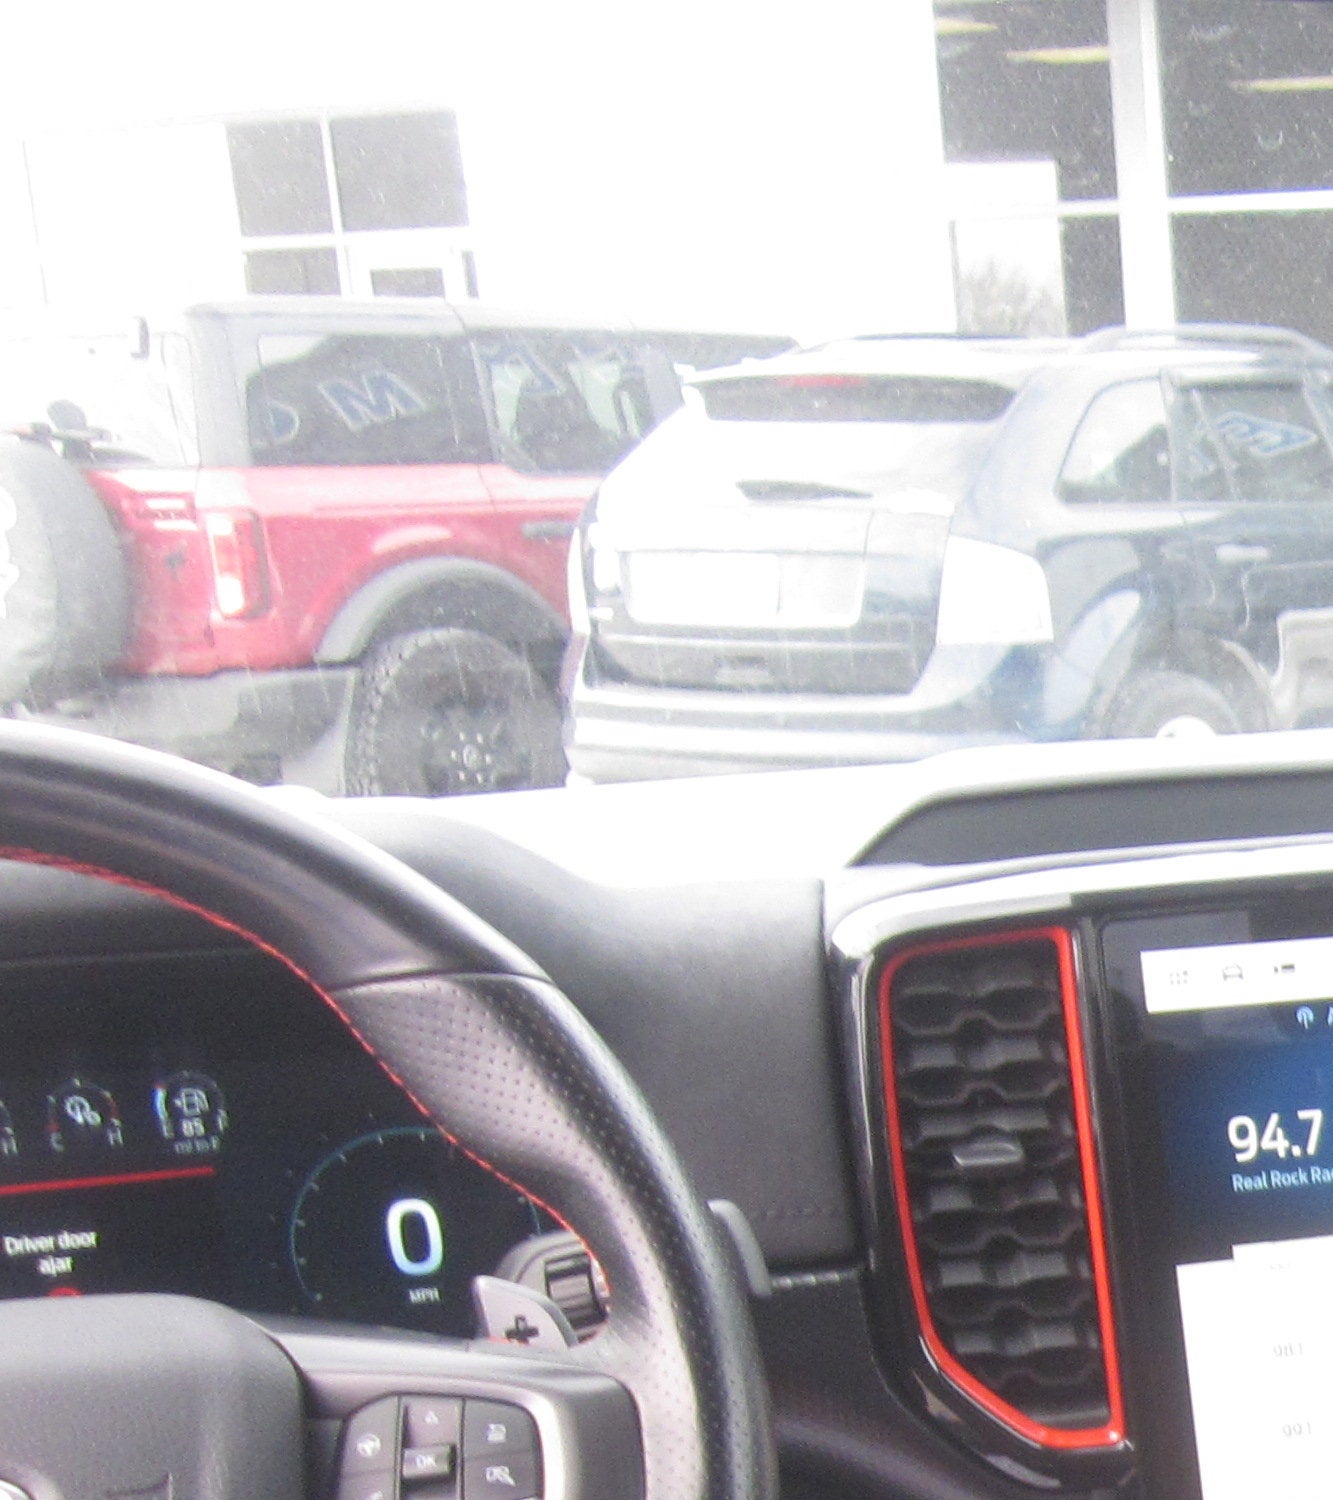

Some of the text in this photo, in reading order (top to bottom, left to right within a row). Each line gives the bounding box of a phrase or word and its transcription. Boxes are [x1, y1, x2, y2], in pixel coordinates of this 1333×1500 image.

[1227, 1108, 1325, 1163] 94.7
[1233, 1171, 1267, 1193] Real
[1271, 1167, 1308, 1187] Rock
[3, 1231, 98, 1256] Driver door
[385, 1198, 444, 1277] 0
[38, 1256, 73, 1278] ajar
[409, 1287, 440, 1305] MPH
